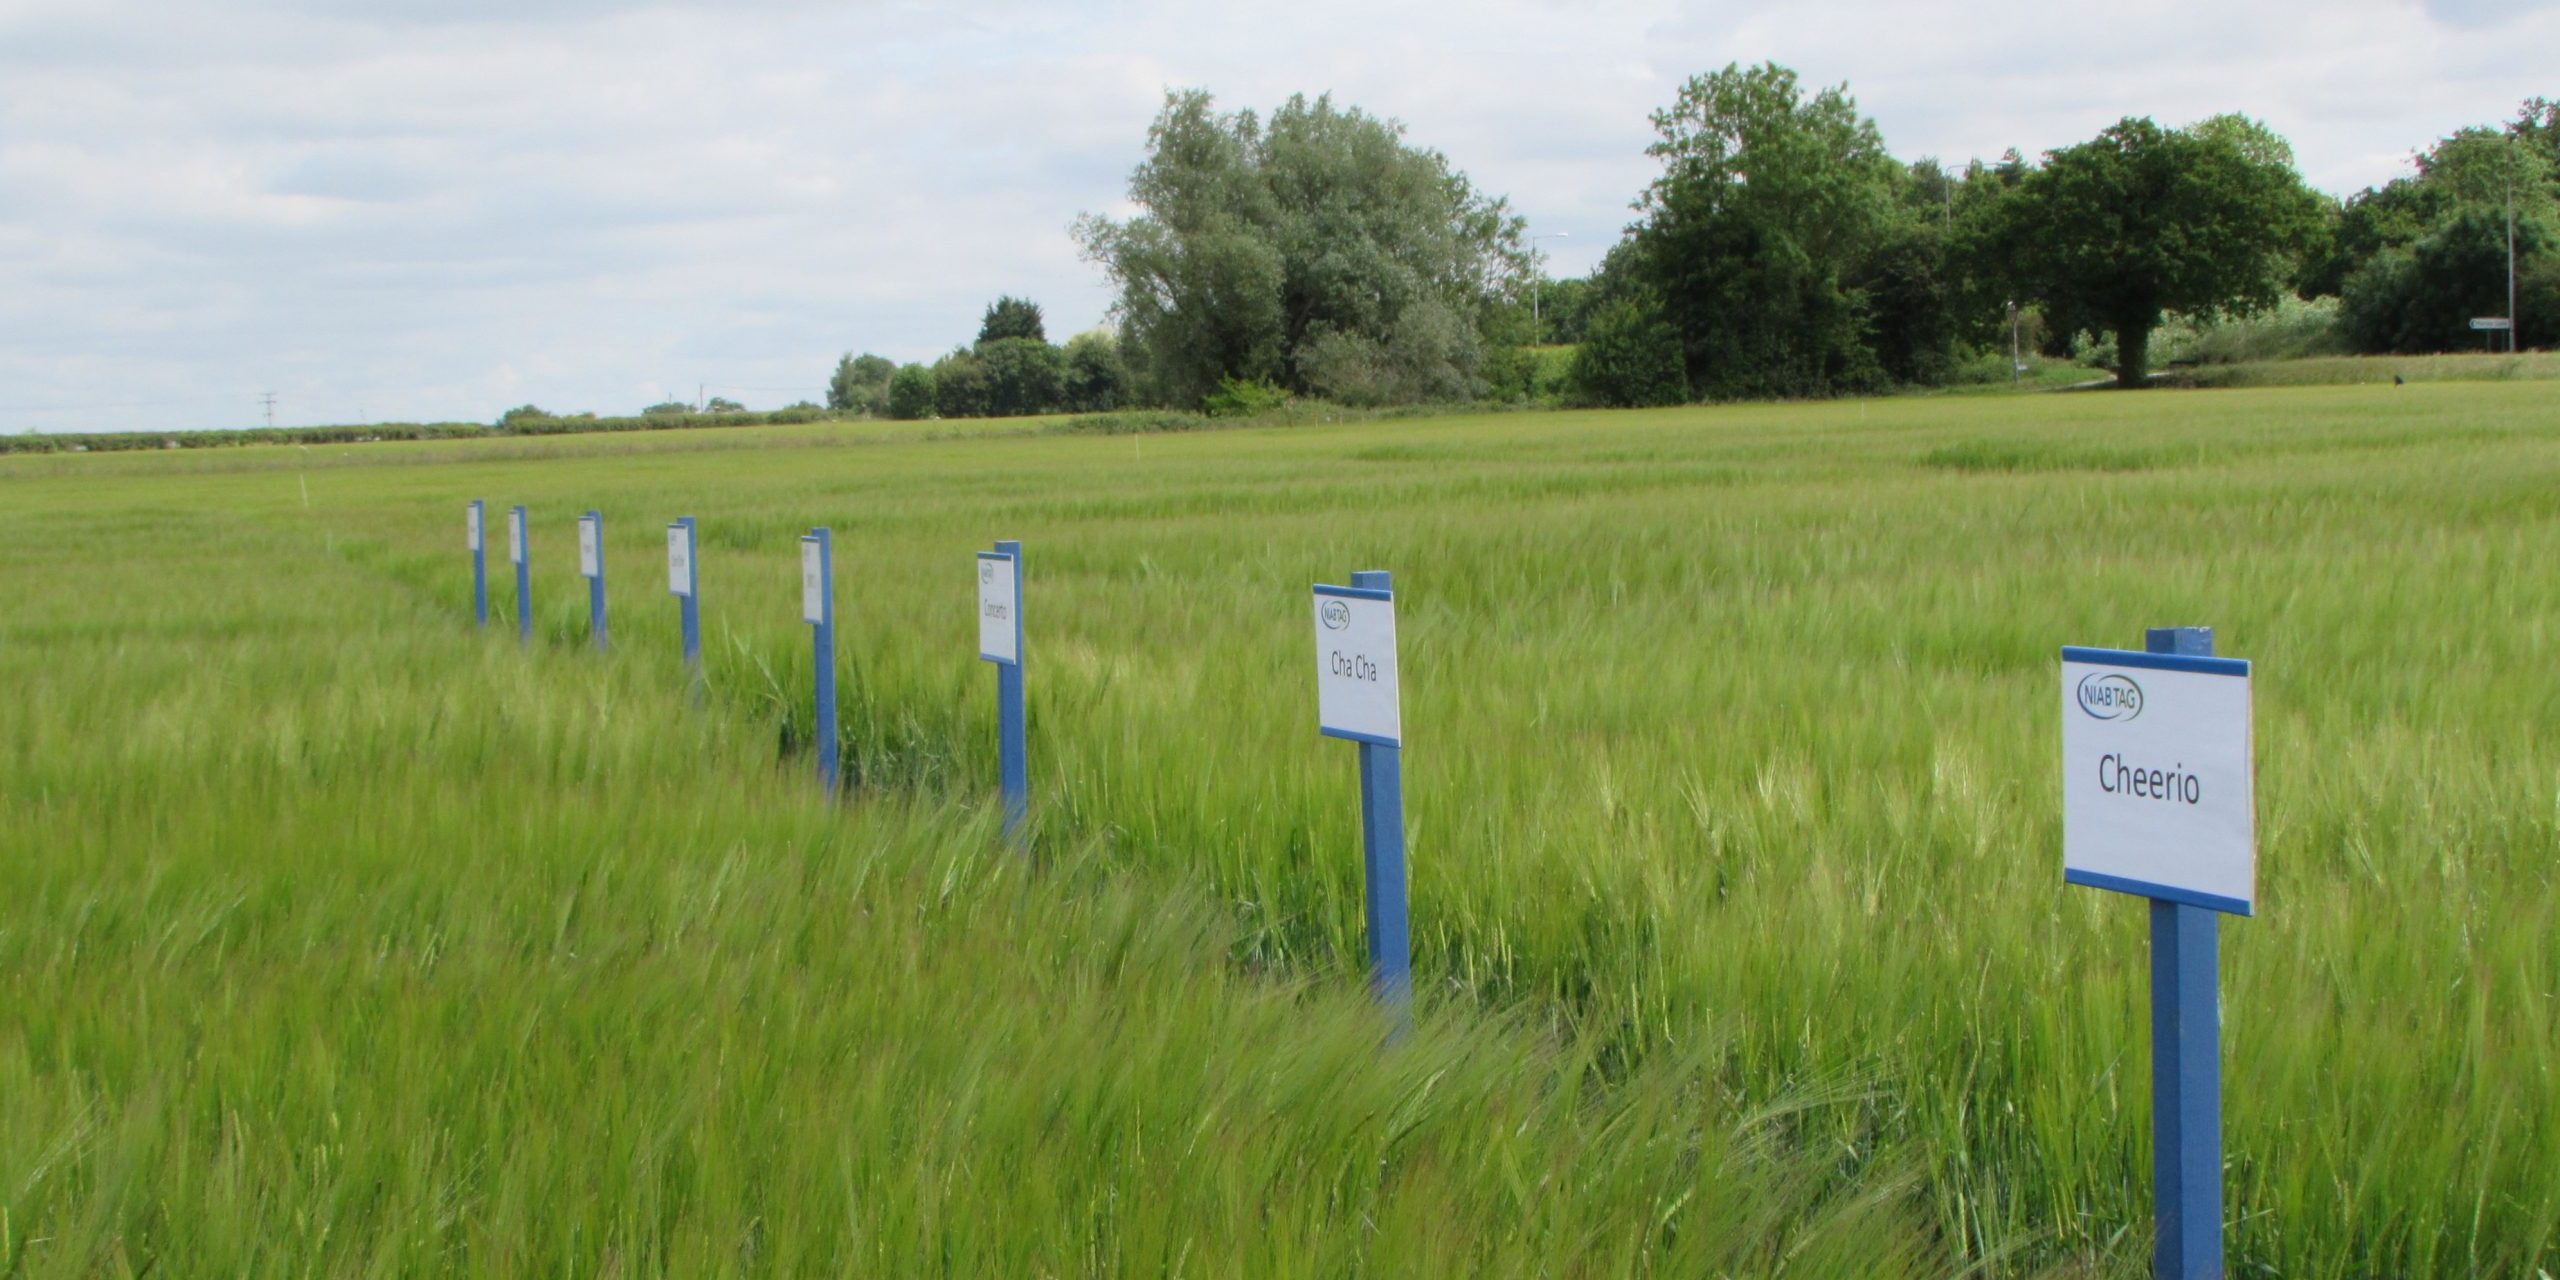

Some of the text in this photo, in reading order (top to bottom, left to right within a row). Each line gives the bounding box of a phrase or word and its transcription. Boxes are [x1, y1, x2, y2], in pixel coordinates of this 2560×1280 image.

[1332, 651, 1377, 682] Cha Cha
[2084, 685, 2135, 708] NIAB TAG
[2100, 754, 2199, 804] Cheerio
